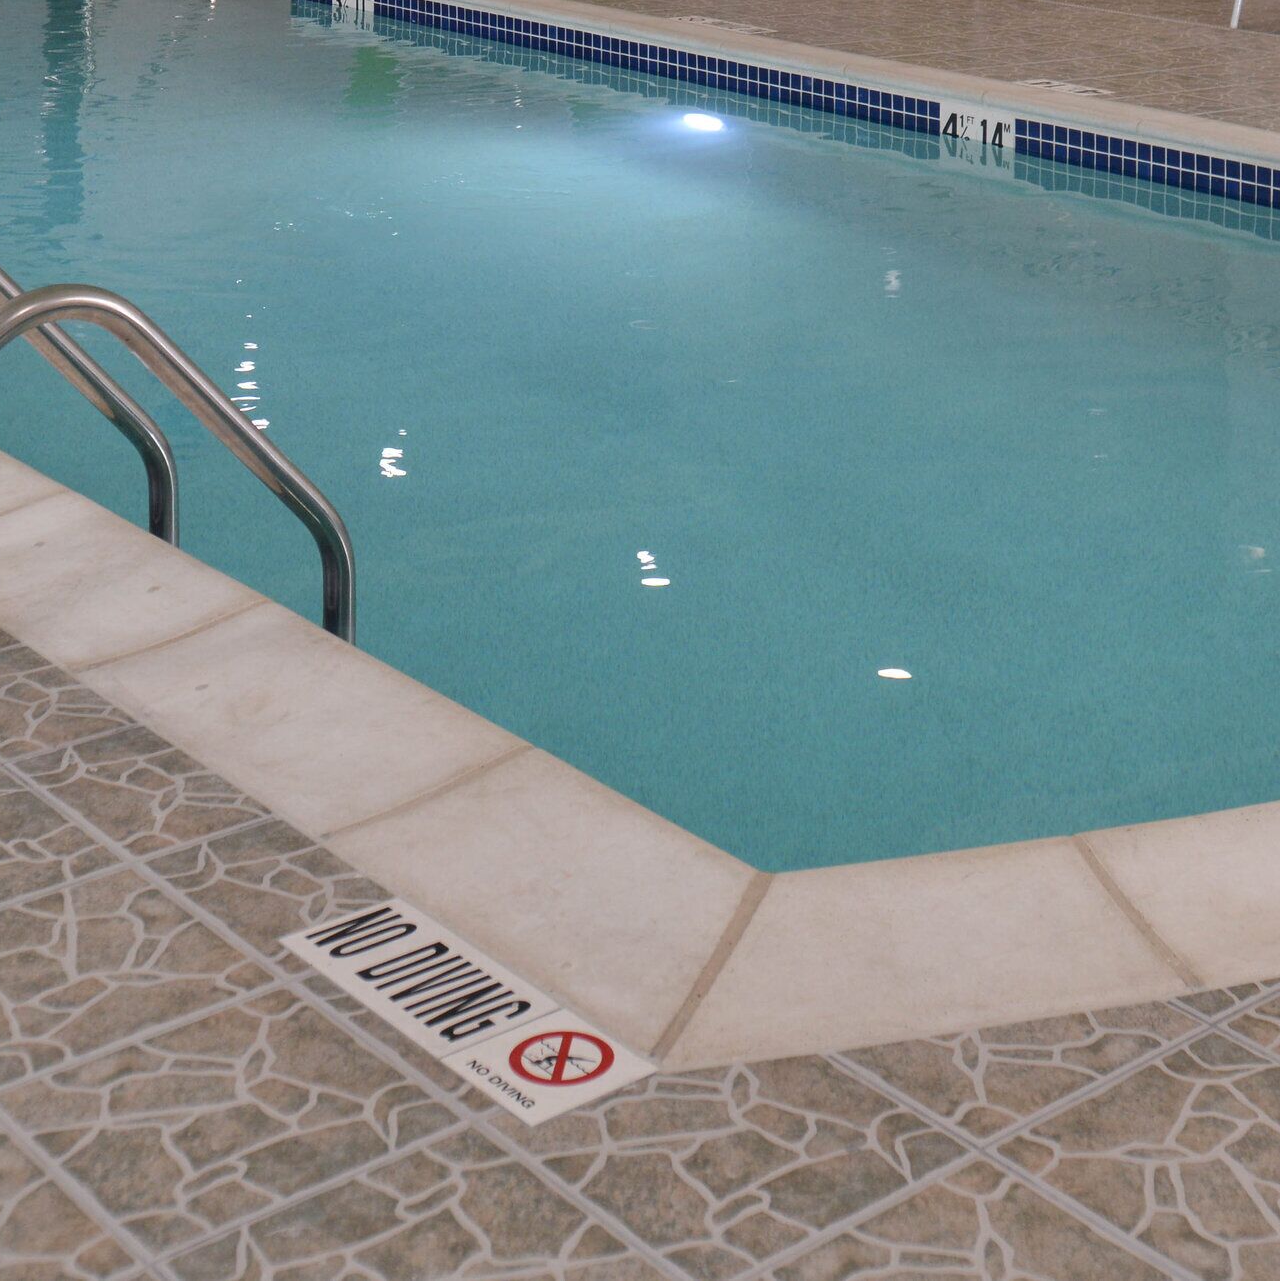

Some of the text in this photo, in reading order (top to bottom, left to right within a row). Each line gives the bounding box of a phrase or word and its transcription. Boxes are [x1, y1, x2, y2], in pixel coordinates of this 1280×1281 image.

[305, 906, 532, 1043] NO DIVING
[466, 1058, 536, 1111] NO DIVING
